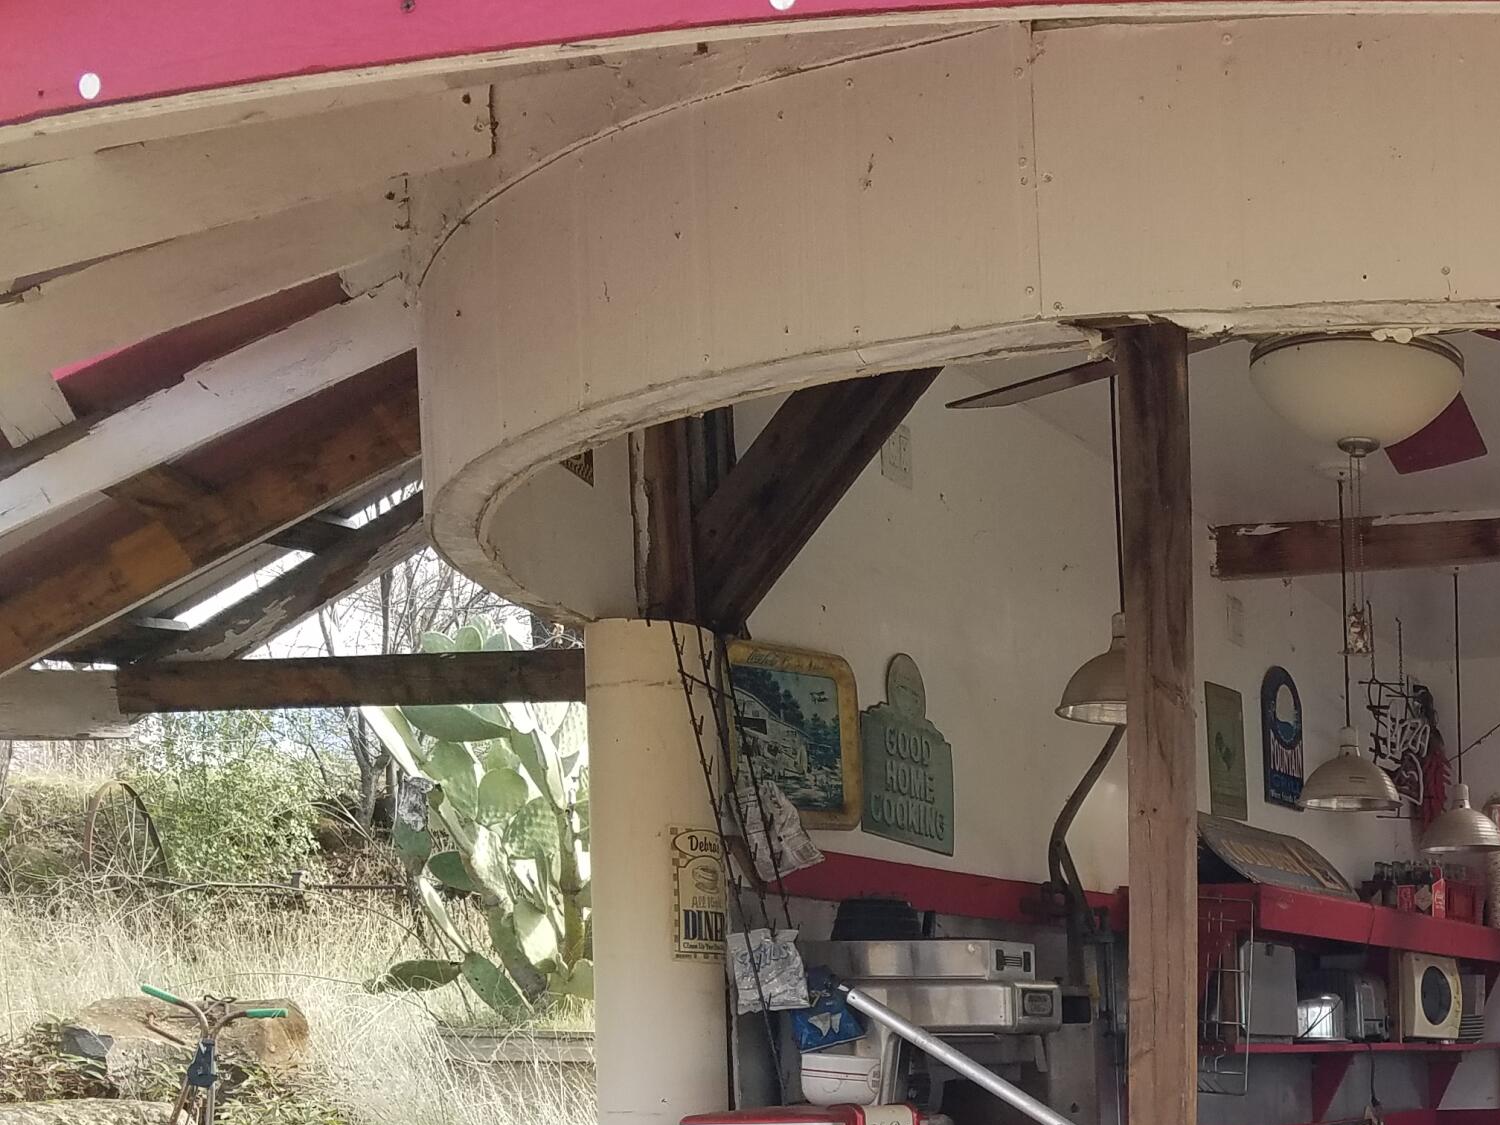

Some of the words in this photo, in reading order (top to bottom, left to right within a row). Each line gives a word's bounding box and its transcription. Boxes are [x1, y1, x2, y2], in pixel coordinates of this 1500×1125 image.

[884, 726, 932, 766] GOOD
[885, 759, 935, 804] HOME
[870, 794, 945, 841] COOKING
